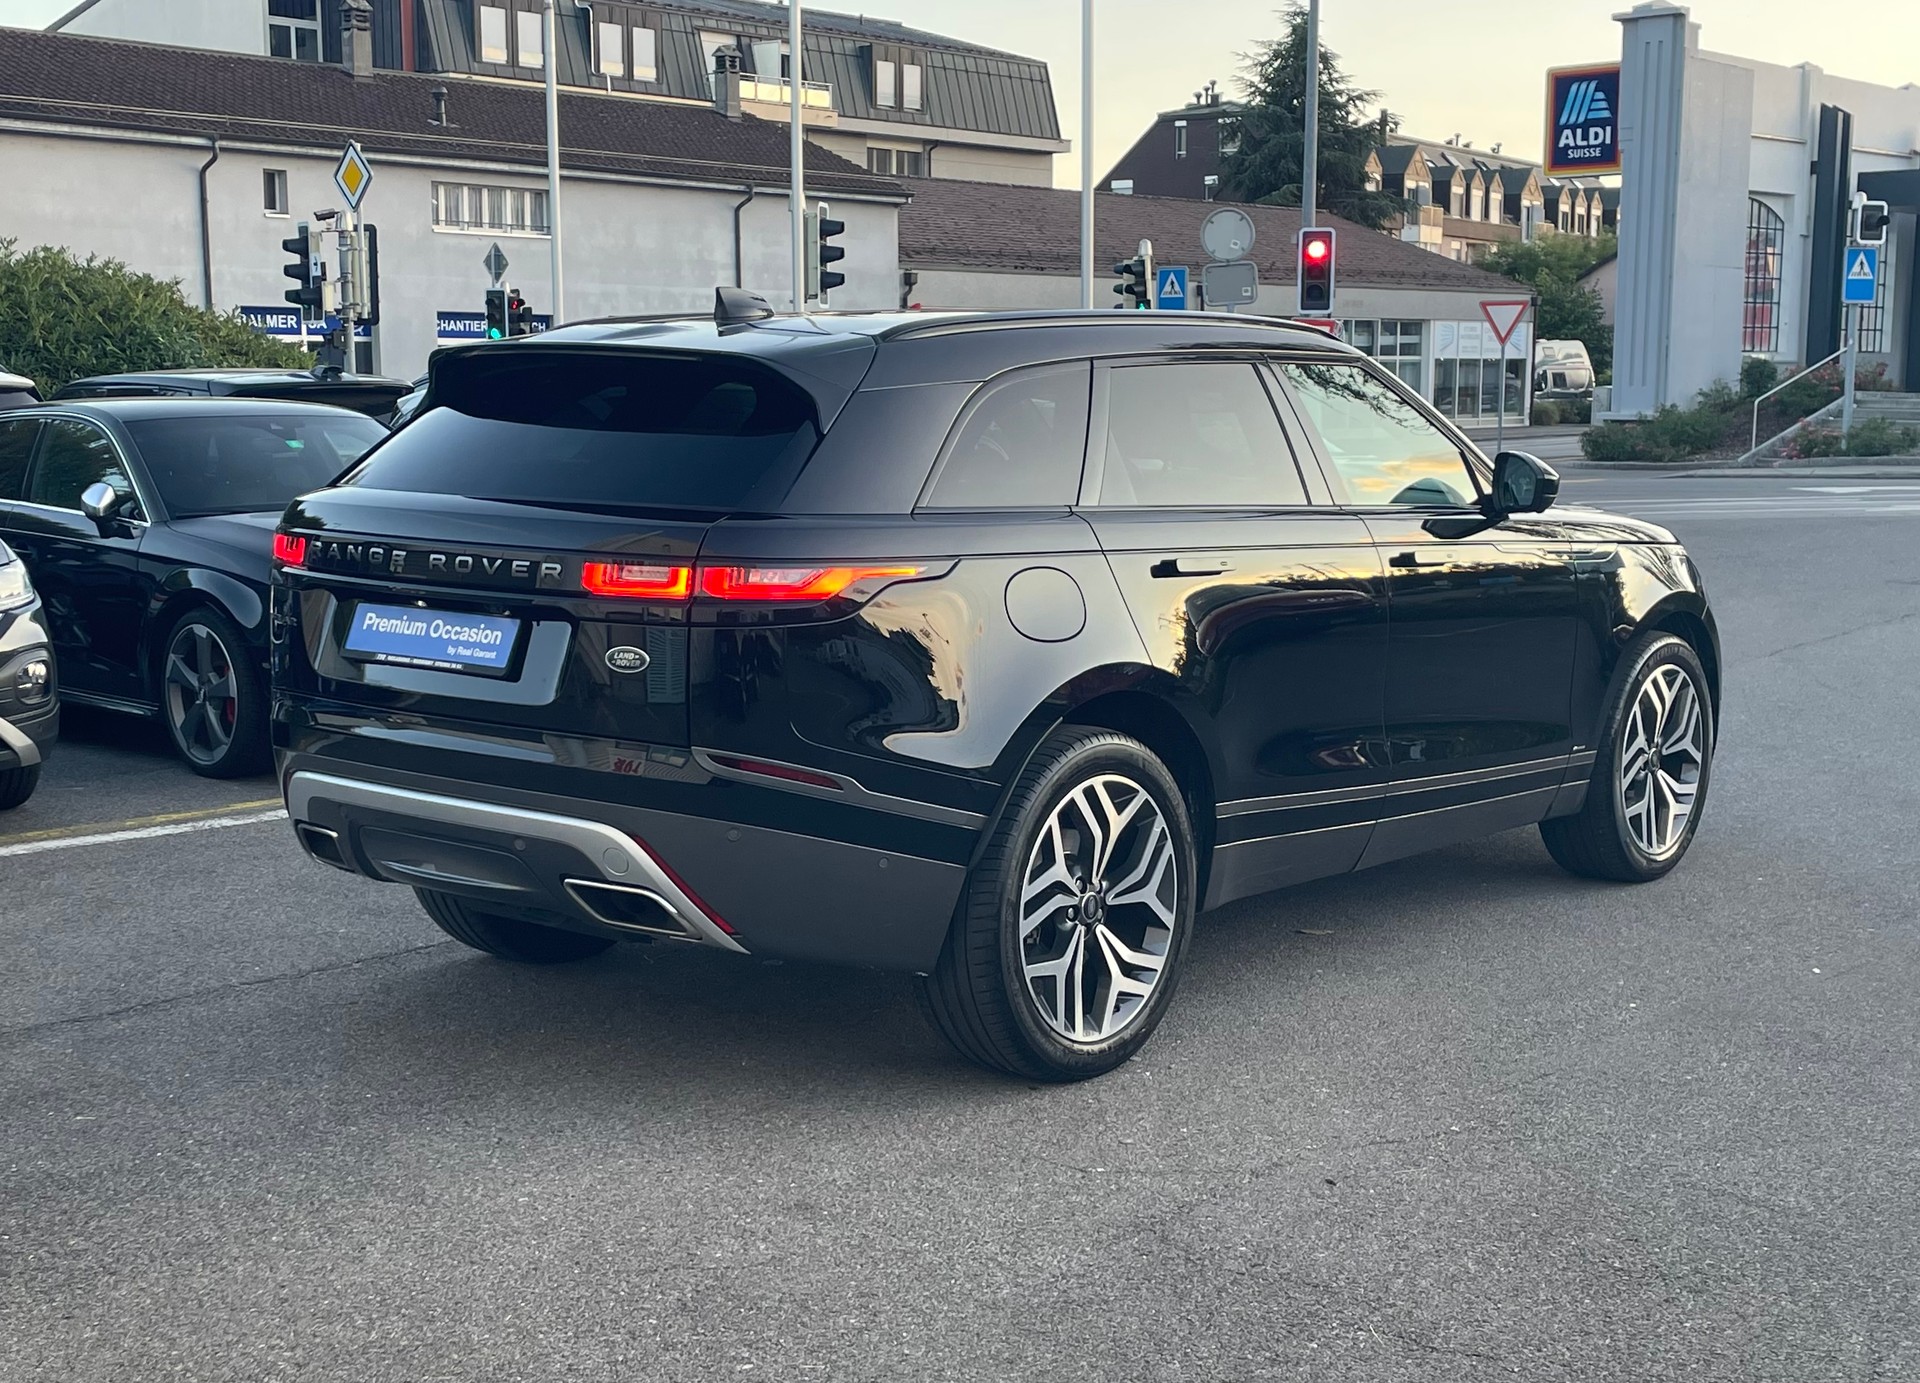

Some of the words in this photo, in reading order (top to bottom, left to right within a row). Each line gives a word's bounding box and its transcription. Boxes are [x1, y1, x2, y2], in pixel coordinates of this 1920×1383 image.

[1558, 125, 1612, 147] ALDI
[1567, 147, 1602, 159] SUISSE
[309, 541, 407, 567] RANGE
[428, 553, 563, 580] ROVER
[363, 612, 427, 637] Premium
[429, 619, 503, 645] Occasion
[446, 645, 457, 656] by
